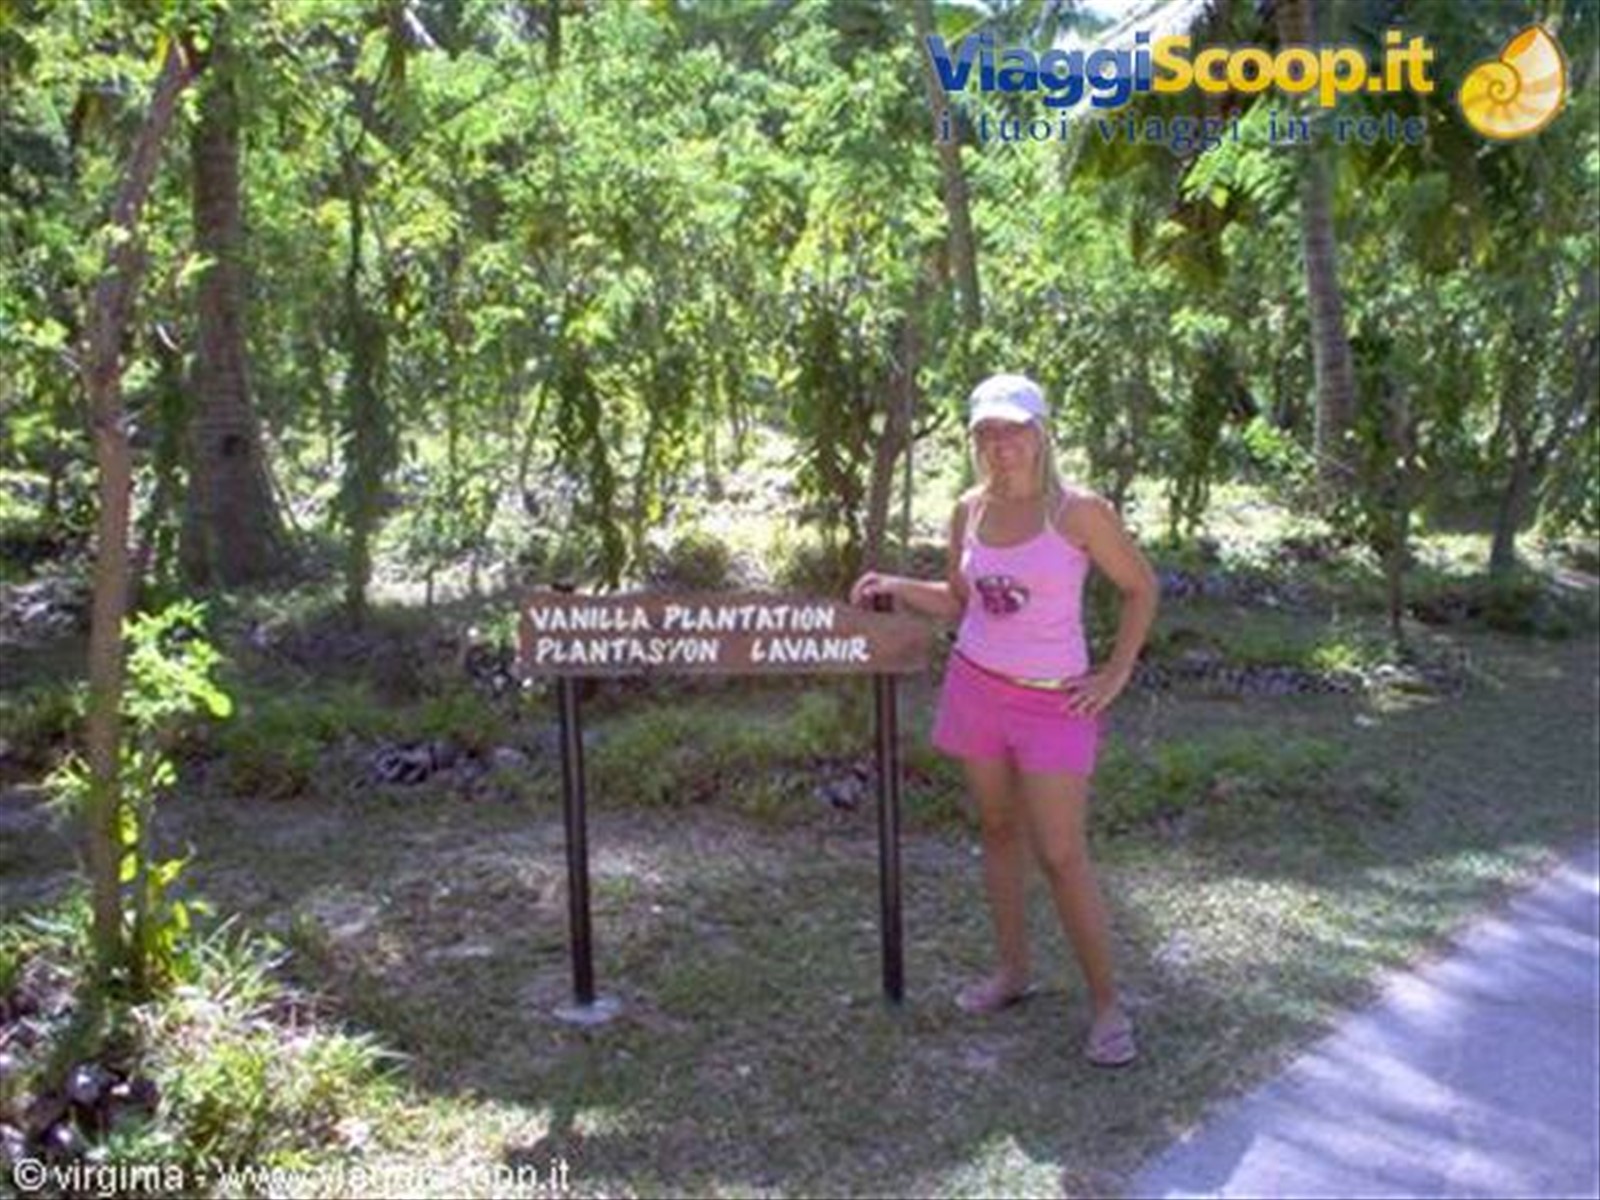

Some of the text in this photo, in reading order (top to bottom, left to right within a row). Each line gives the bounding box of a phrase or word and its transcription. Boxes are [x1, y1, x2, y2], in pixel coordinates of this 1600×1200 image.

[529, 603, 835, 632] VANILLA PLANTATION
[536, 635, 871, 665] PLANTASYON LAVANIR
